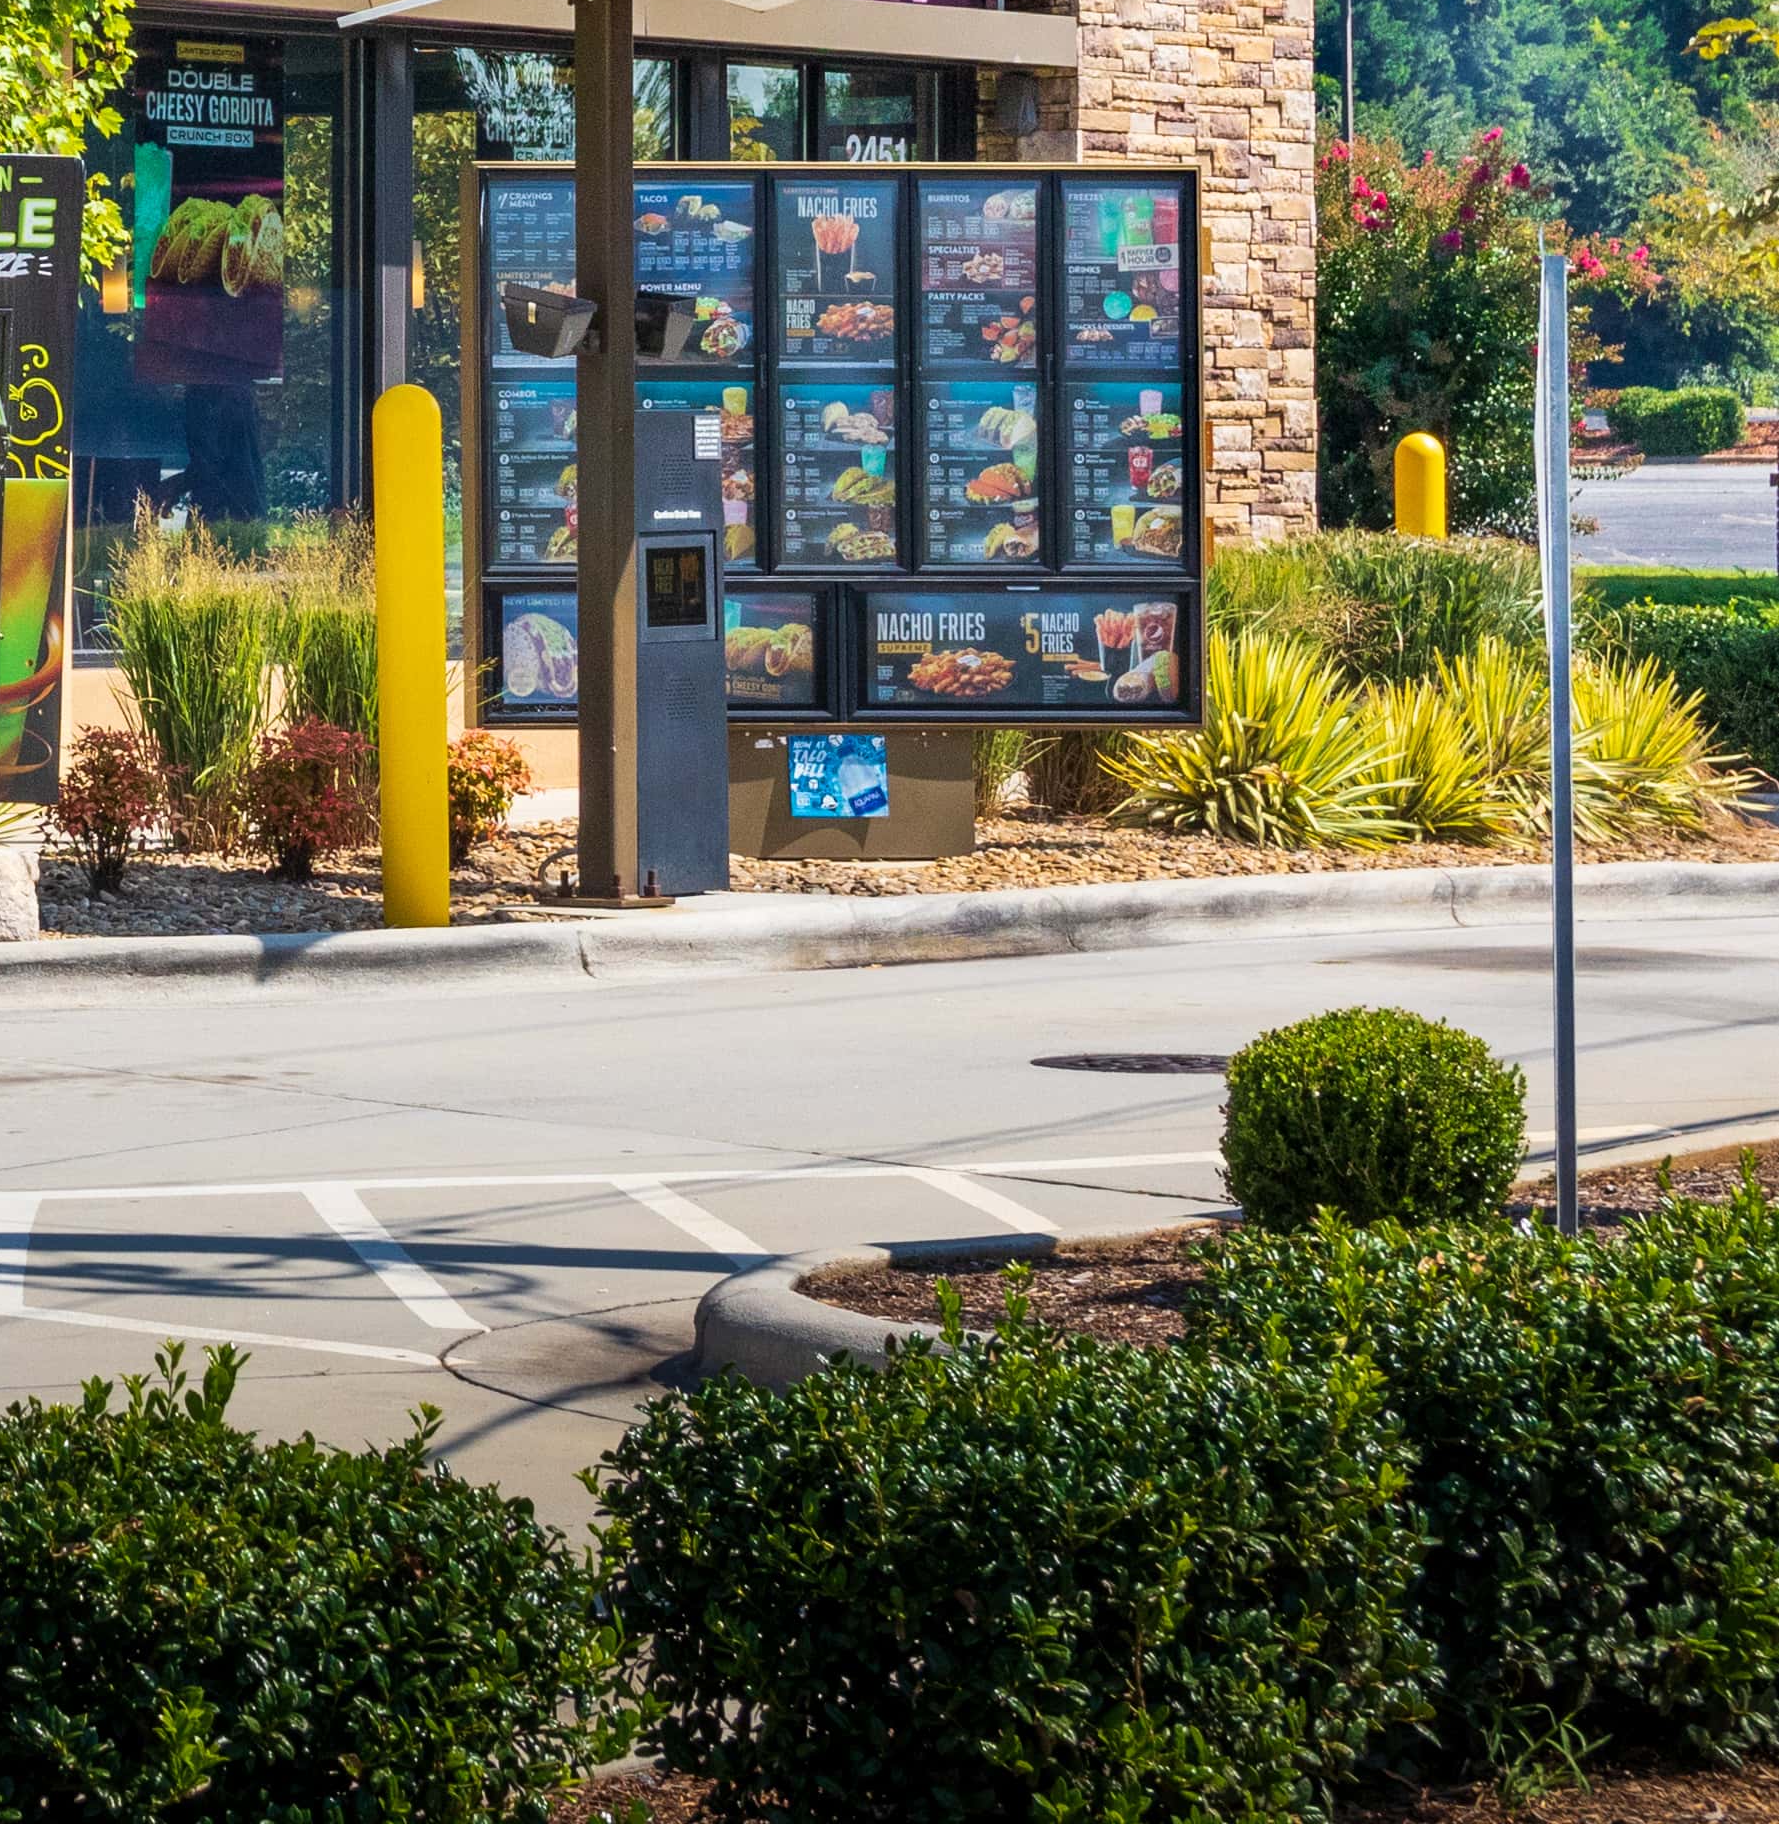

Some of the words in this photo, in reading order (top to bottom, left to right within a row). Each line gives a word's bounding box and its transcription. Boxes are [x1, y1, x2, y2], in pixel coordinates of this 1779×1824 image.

[168, 68, 254, 92] DOUBLE
[146, 91, 204, 124] CHEESY
[209, 94, 274, 127] GORDITA
[169, 129, 221, 142] CRUNCH
[225, 132, 251, 144] BOX
[846, 133, 908, 162] 2451
[509, 192, 554, 201] CRAVINGS
[509, 200, 536, 208] MENU
[639, 195, 668, 203] TACOS
[798, 196, 839, 218] NACHO
[843, 197, 877, 218] FRIES
[928, 246, 980, 254] SPECIALTIES
[1127, 255, 1155, 265] HOUR
[1068, 266, 1101, 274] DRINKS
[640, 283, 672, 292] POWER
[673, 282, 702, 291] MENU
[928, 292, 955, 301] PARTY
[957, 292, 985, 301] PACKS
[786, 299, 816, 314] NACHO
[786, 314, 811, 329] FRIES
[498, 390, 537, 398] COMBOS
[877, 613, 933, 641] NACHO
[938, 612, 985, 641] FRIES
[1019, 612, 1040, 654] $5
[1042, 612, 1079, 633] NACHO
[881, 644, 928, 652] SUPREME
[1042, 633, 1074, 653] FRIES
[793, 749, 827, 765] TACO
[794, 762, 826, 779] BELL
